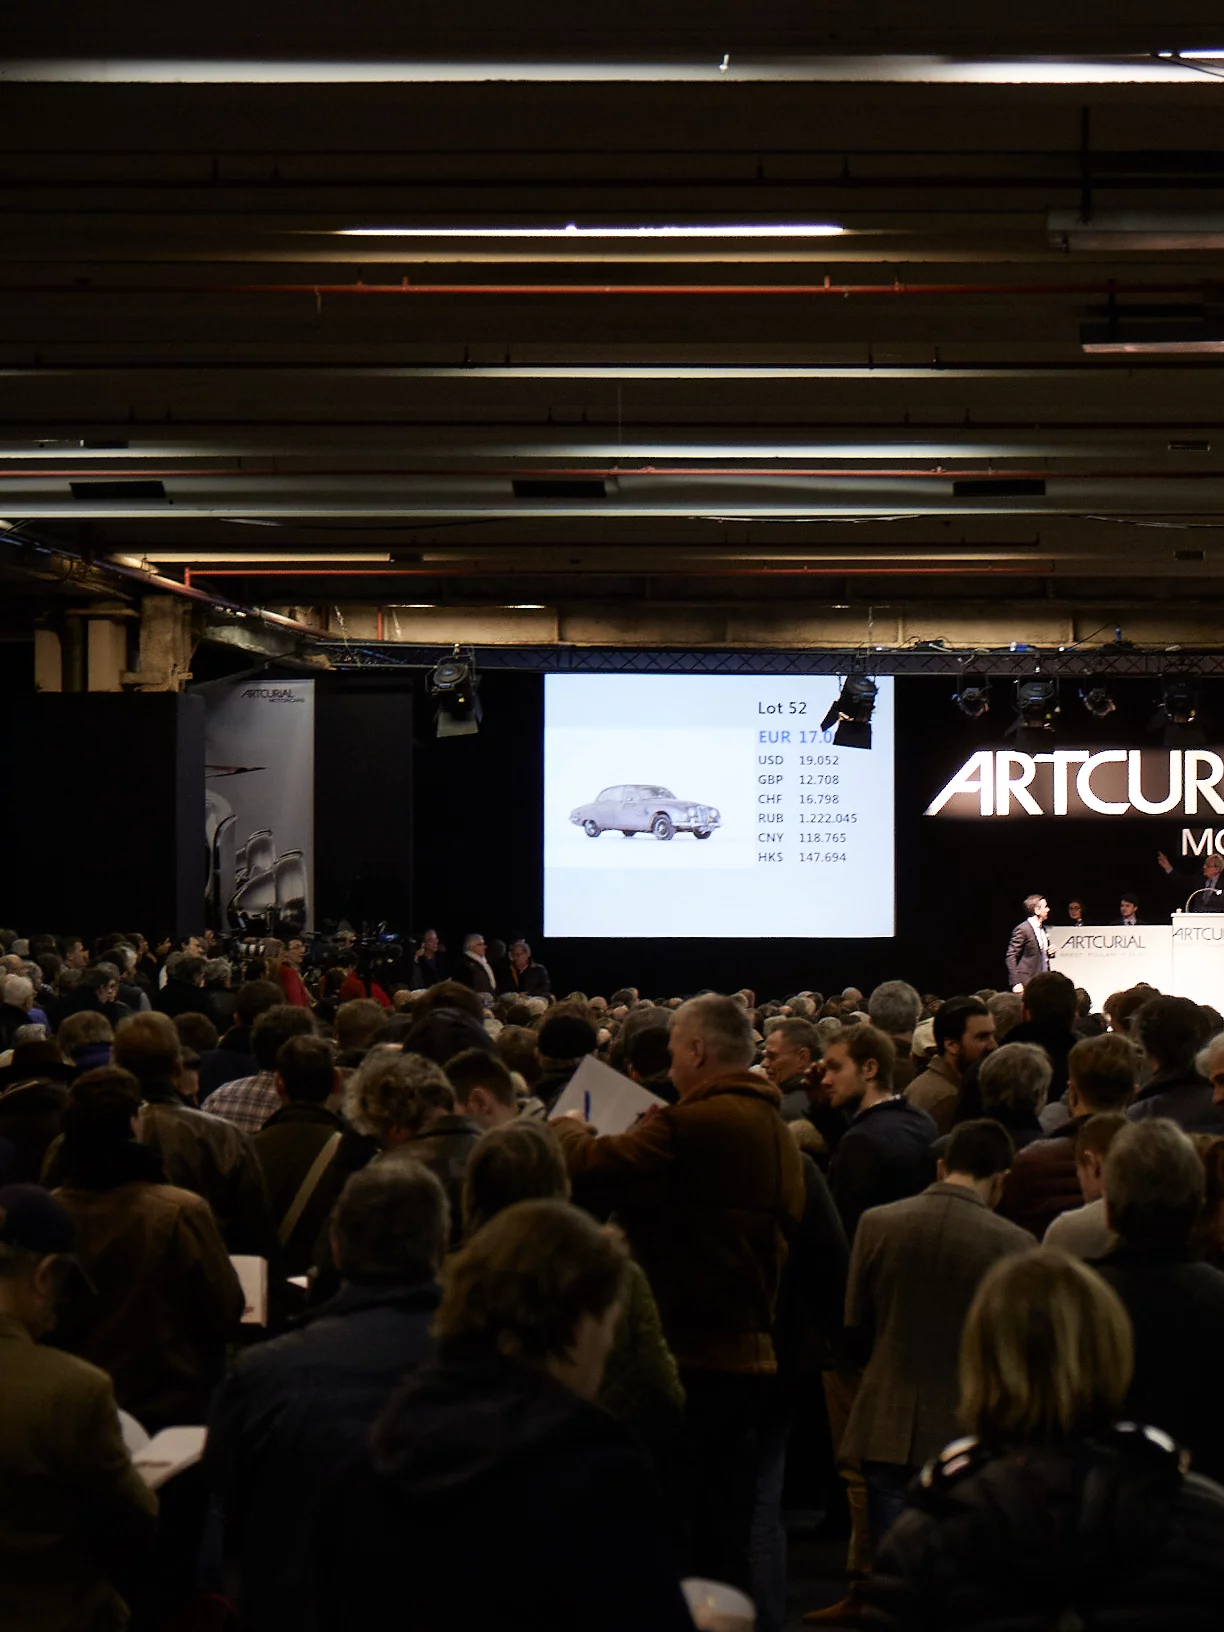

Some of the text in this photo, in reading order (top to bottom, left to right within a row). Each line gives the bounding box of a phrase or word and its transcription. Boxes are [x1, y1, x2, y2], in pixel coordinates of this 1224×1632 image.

[241, 689, 294, 699] ARTCURIAL
[758, 702, 807, 714] Lot 52
[759, 730, 834, 743] EUR 17.0
[758, 755, 784, 765] USD
[758, 775, 840, 785] GBP 12.708
[758, 794, 840, 804] CHF 16.798
[758, 813, 858, 823] RUB 1.222.045
[758, 832, 847, 842] CNY 118.765
[799, 852, 847, 862] 147.694
[1061, 935, 1146, 949] ARTCURIAL
